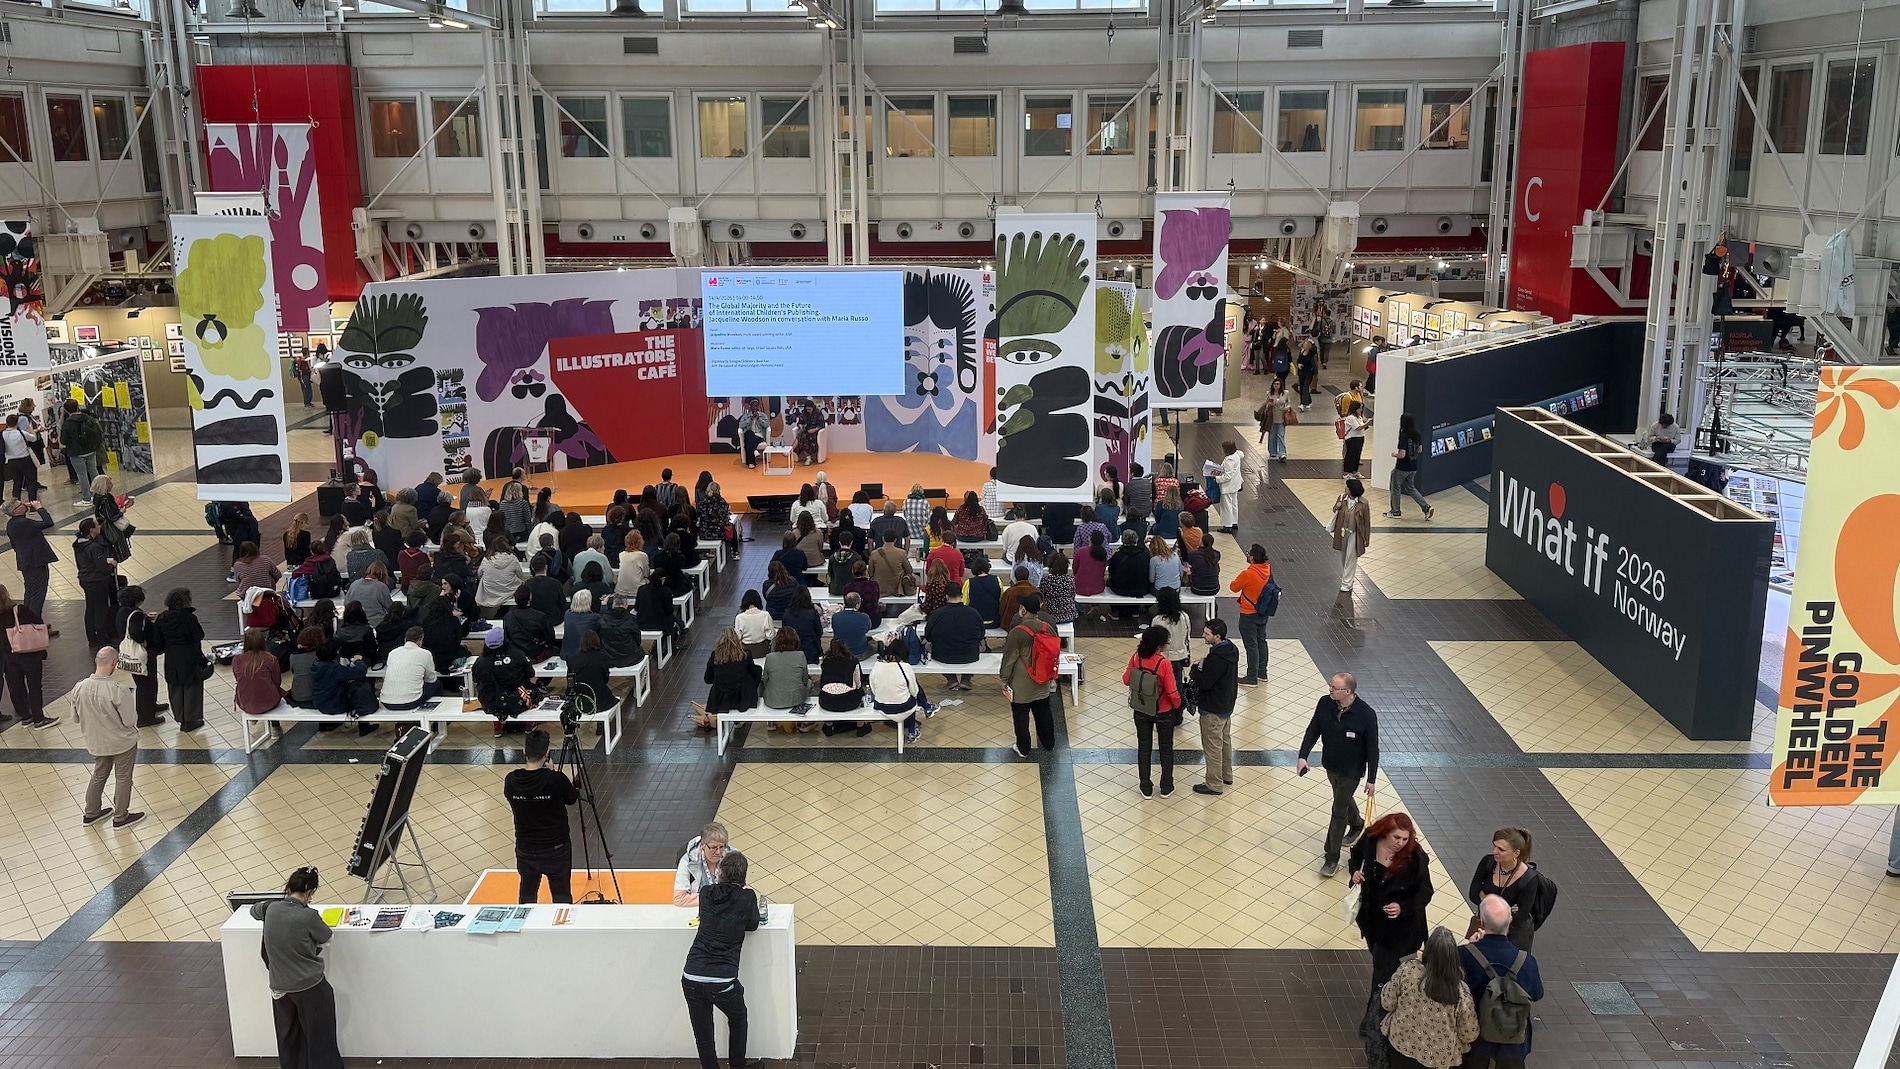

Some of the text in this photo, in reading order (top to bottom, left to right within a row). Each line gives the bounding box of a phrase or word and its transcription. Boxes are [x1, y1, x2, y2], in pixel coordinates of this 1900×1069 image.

[1525, 176, 1543, 222] C
[708, 316, 740, 324] Jacqueline
[741, 302, 767, 310] Majority
[0, 316, 17, 366] VISIONS
[17, 352, 28, 366] 10
[556, 348, 676, 372] ILLUSTRATORS
[644, 334, 675, 350] THE
[637, 361, 677, 380] CAFÉ
[1499, 469, 1610, 596] What if
[1616, 546, 1666, 602] 2026
[1613, 579, 1687, 662] Norway
[1783, 601, 1836, 790] PINWHEEL
[1816, 652, 1863, 788] GOLDEN
[1850, 720, 1888, 788] THE
